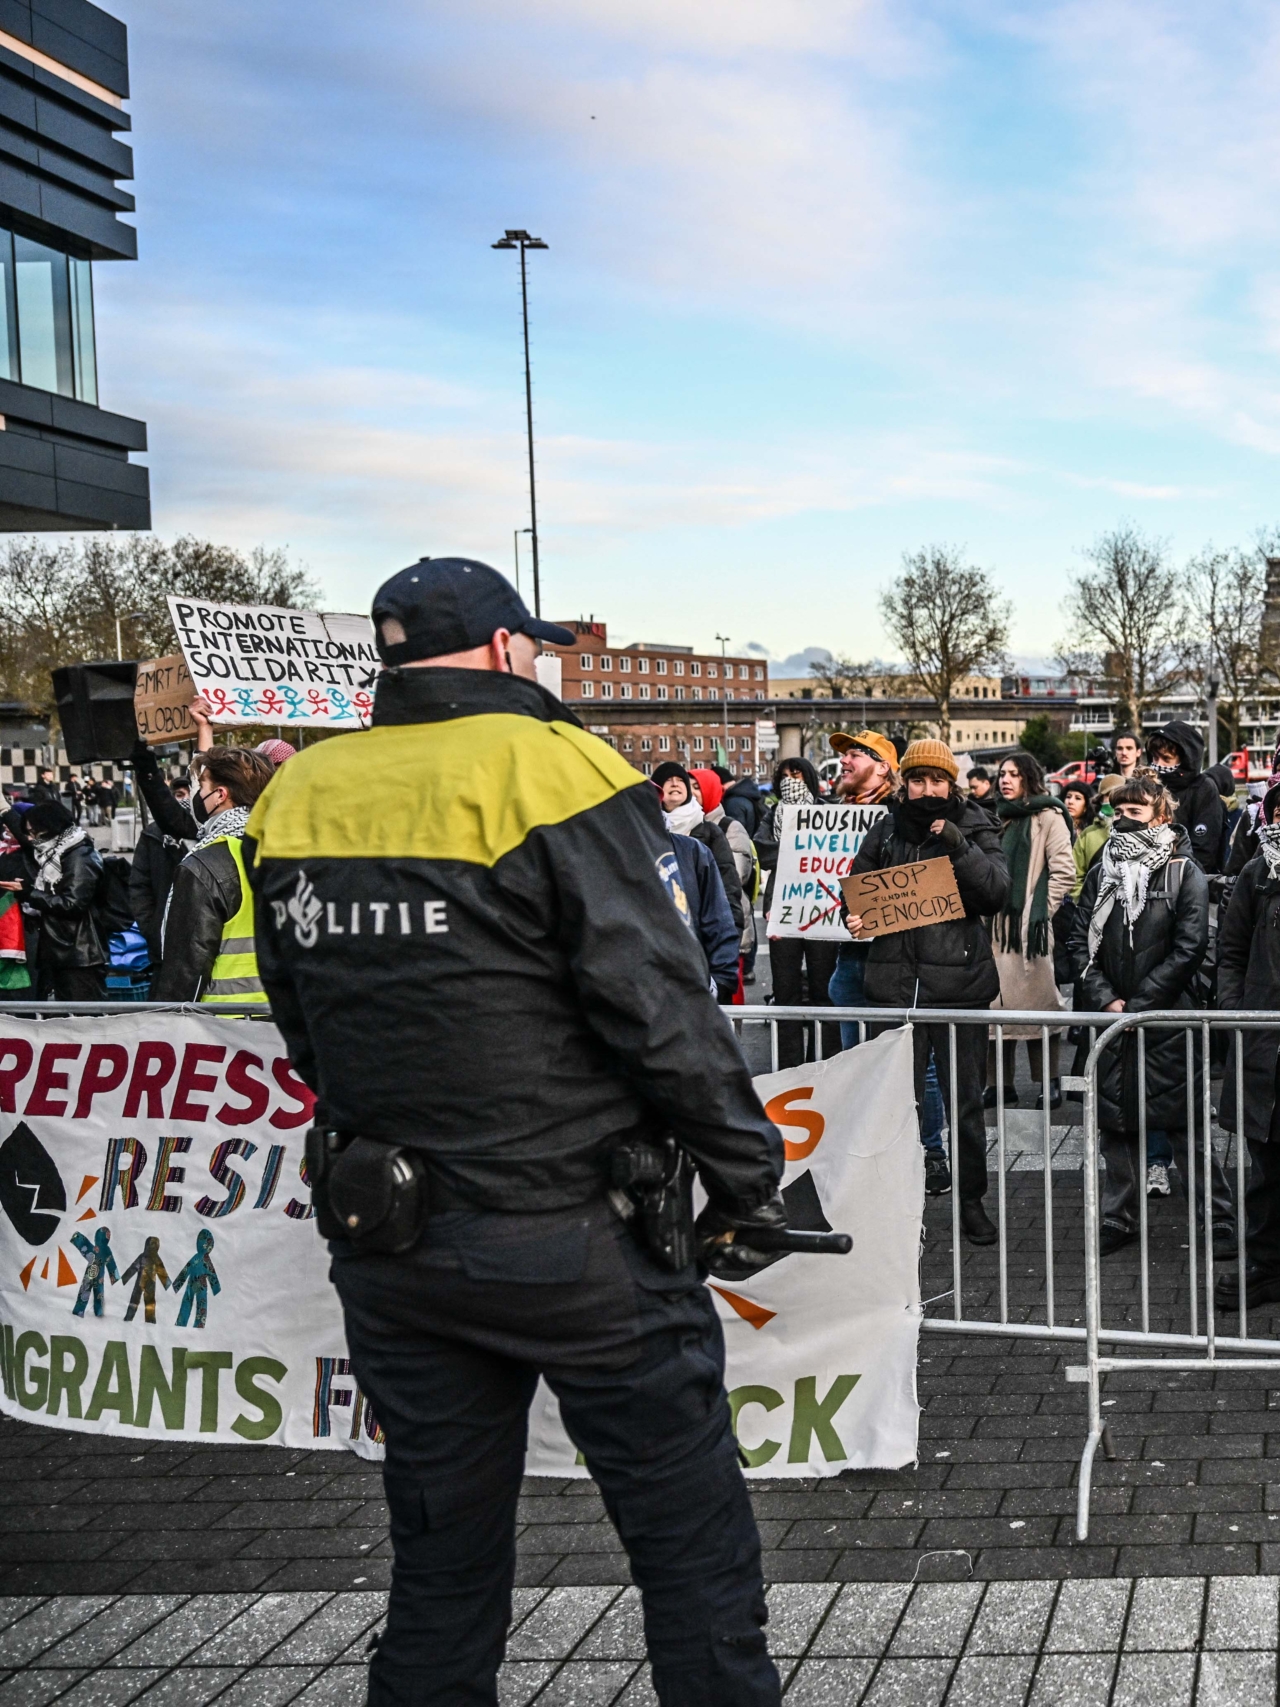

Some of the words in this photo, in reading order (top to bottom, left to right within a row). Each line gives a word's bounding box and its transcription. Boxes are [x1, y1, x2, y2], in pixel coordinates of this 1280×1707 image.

[176, 603, 307, 635] PROMOTE
[179, 627, 382, 662] INTERNATIONAL
[135, 667, 174, 697] SMRT
[190, 651, 379, 688] SOLIDARITY
[137, 705, 195, 735] SLOBOD
[795, 833, 866, 853] LIVELI
[858, 864, 928, 896] STOP
[861, 892, 962, 931] GENOCIDE
[871, 890, 917, 903] FUNDING
[0, 1324, 289, 1441] IGRANTS
